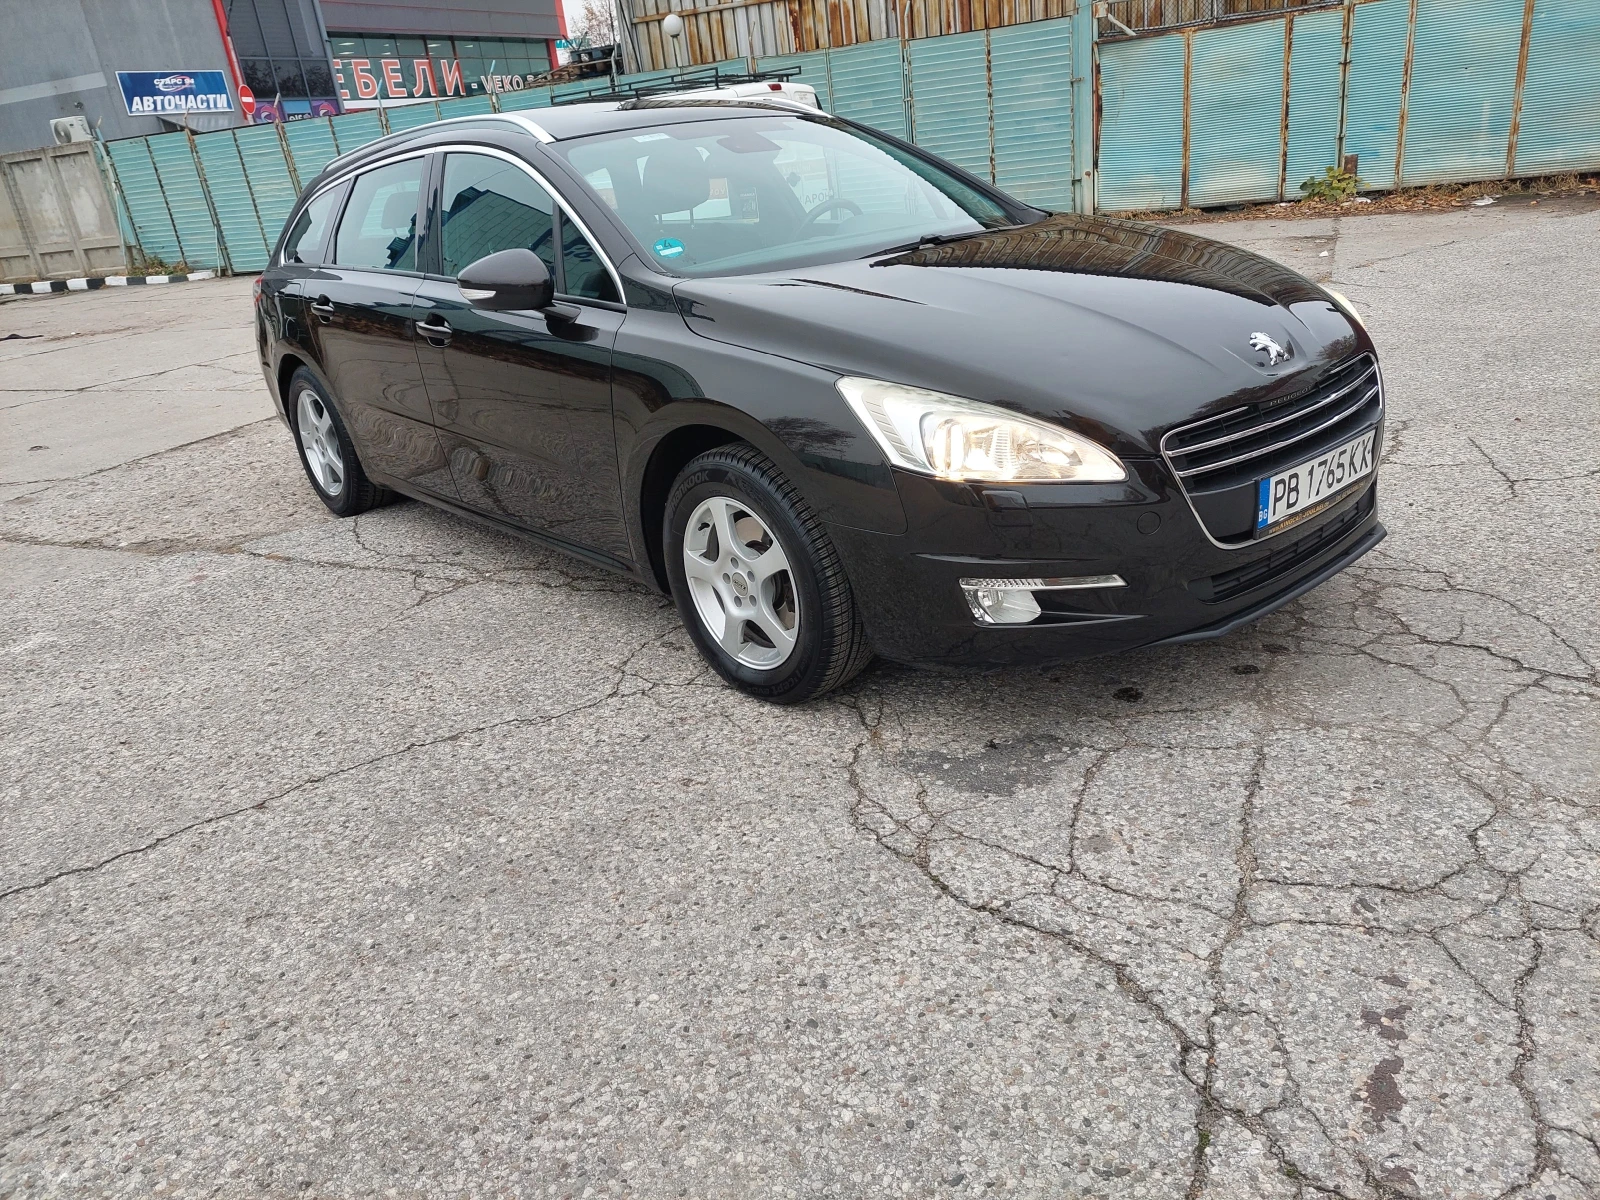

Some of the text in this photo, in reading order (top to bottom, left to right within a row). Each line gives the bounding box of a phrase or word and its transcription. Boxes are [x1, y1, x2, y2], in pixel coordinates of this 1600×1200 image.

[131, 93, 228, 112] АВТОЧАСТИ
[1272, 471, 1300, 517] PB
[1258, 508, 1268, 522] BG
